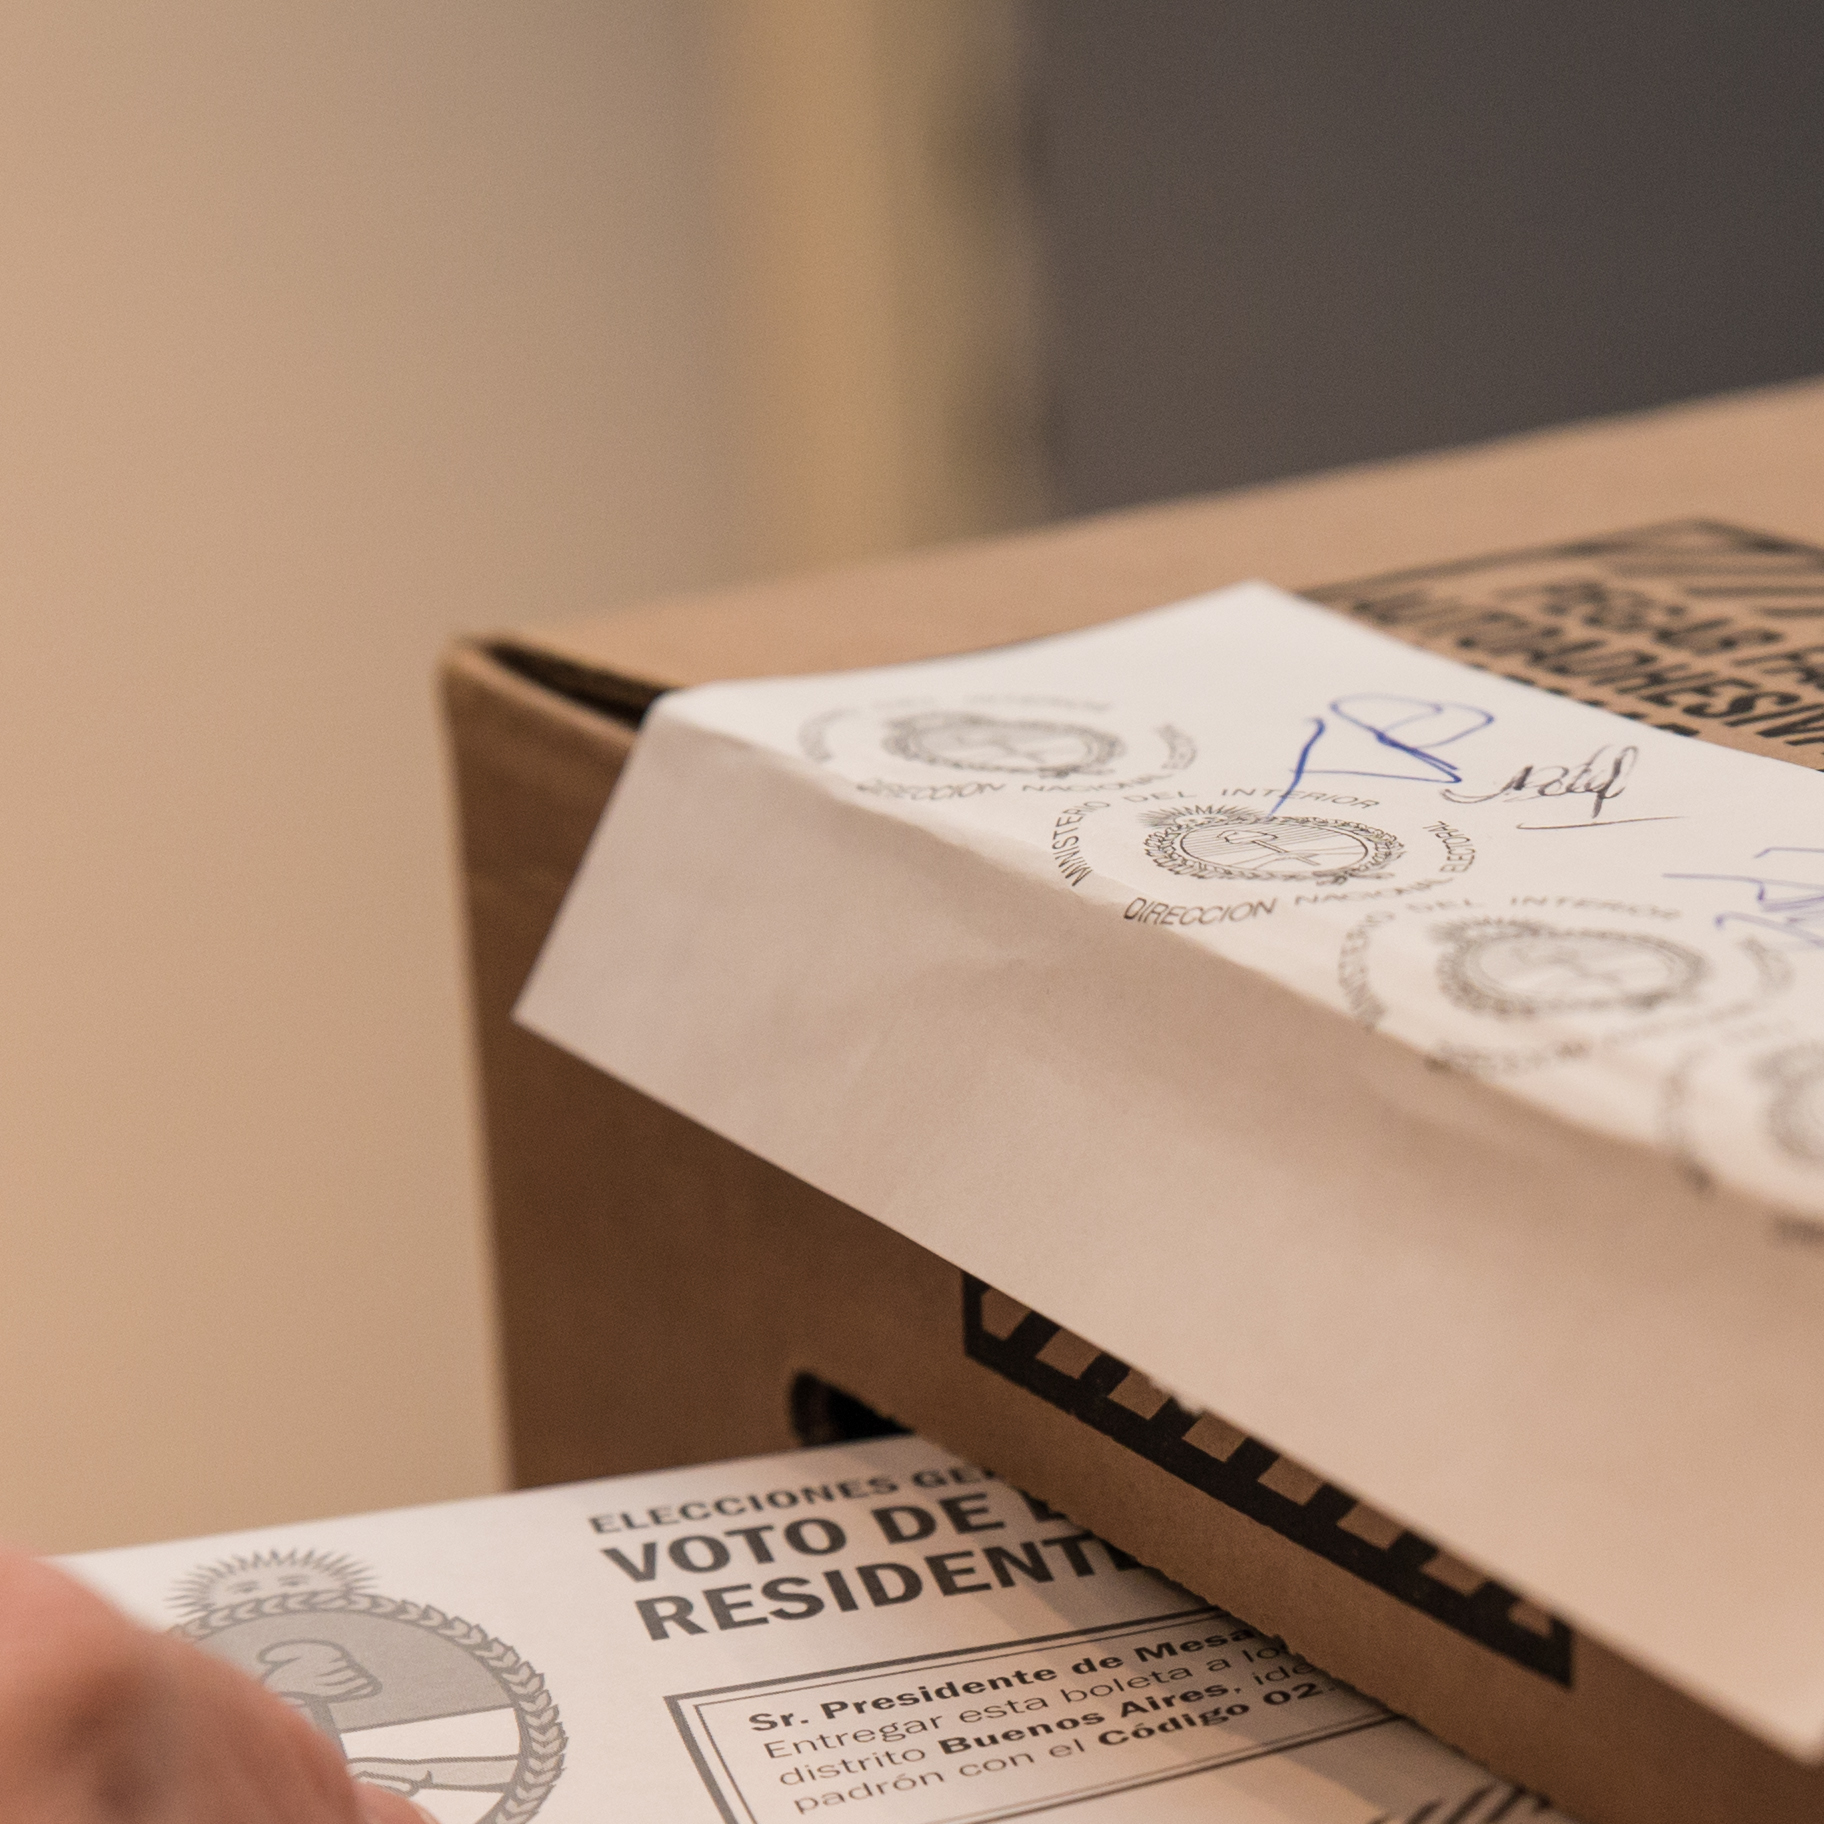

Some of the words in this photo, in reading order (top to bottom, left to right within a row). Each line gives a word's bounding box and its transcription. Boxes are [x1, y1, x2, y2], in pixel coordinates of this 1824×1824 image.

[1052, 800, 1111, 887] MINISTERIO
[1123, 790, 1197, 803] DEL
[1221, 788, 1380, 811] INTERIOR
[1123, 896, 1276, 926] DIRECCION
[1422, 820, 1476, 875] ELECTORAL
[589, 1476, 899, 1535] ELECCIONES
[600, 1516, 848, 1583] VOTO
[871, 1492, 1007, 1545] DE
[748, 1709, 810, 1732] Sr.
[819, 1665, 1058, 1720] Presidente
[1070, 1649, 1124, 1674] de
[1132, 1628, 1257, 1664] Mesa
[762, 1712, 944, 1760] Entregar
[958, 1693, 1049, 1722] esta
[1059, 1664, 1194, 1703] boleta
[1206, 1658, 1231, 1672] a
[778, 1744, 926, 1787] distrito
[937, 1709, 1107, 1756] Buenos
[791, 1769, 946, 1814] padrón
[956, 1750, 1036, 1778] con
[1047, 1738, 1086, 1759] el
[1095, 1699, 1251, 1748] Código
